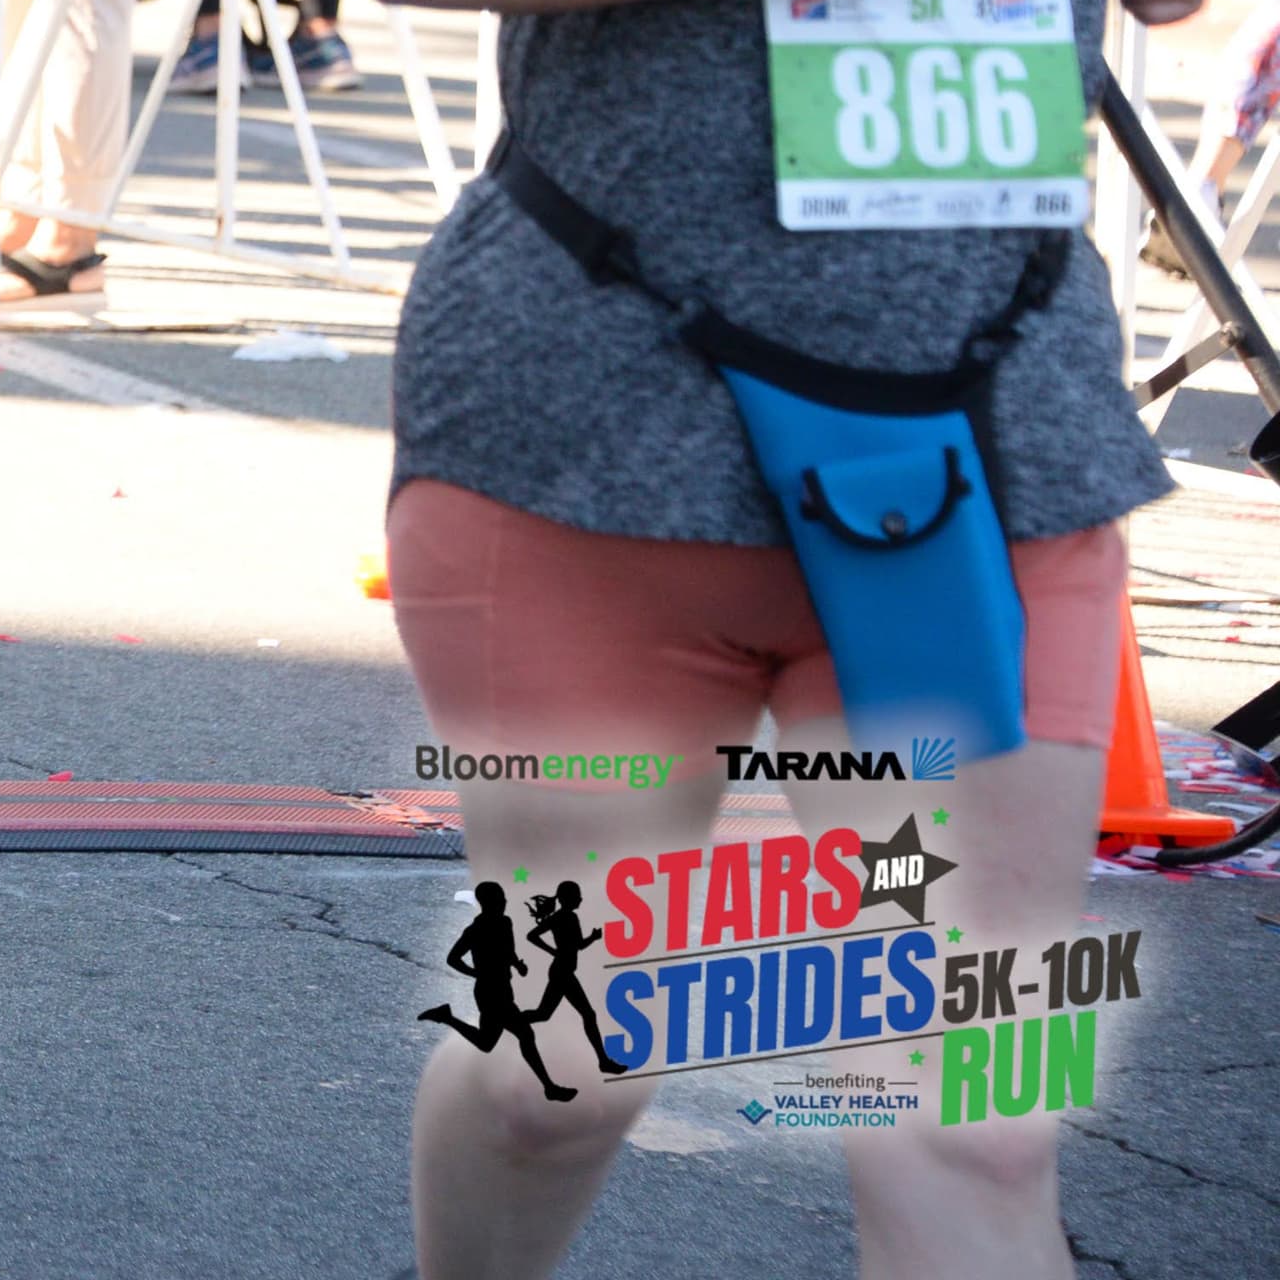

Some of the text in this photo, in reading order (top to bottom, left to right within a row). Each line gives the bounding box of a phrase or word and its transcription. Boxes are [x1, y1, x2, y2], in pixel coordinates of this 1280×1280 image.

[831, 46, 1038, 169] 866
[801, 195, 850, 217] DRINK
[1034, 194, 1072, 216] 866
